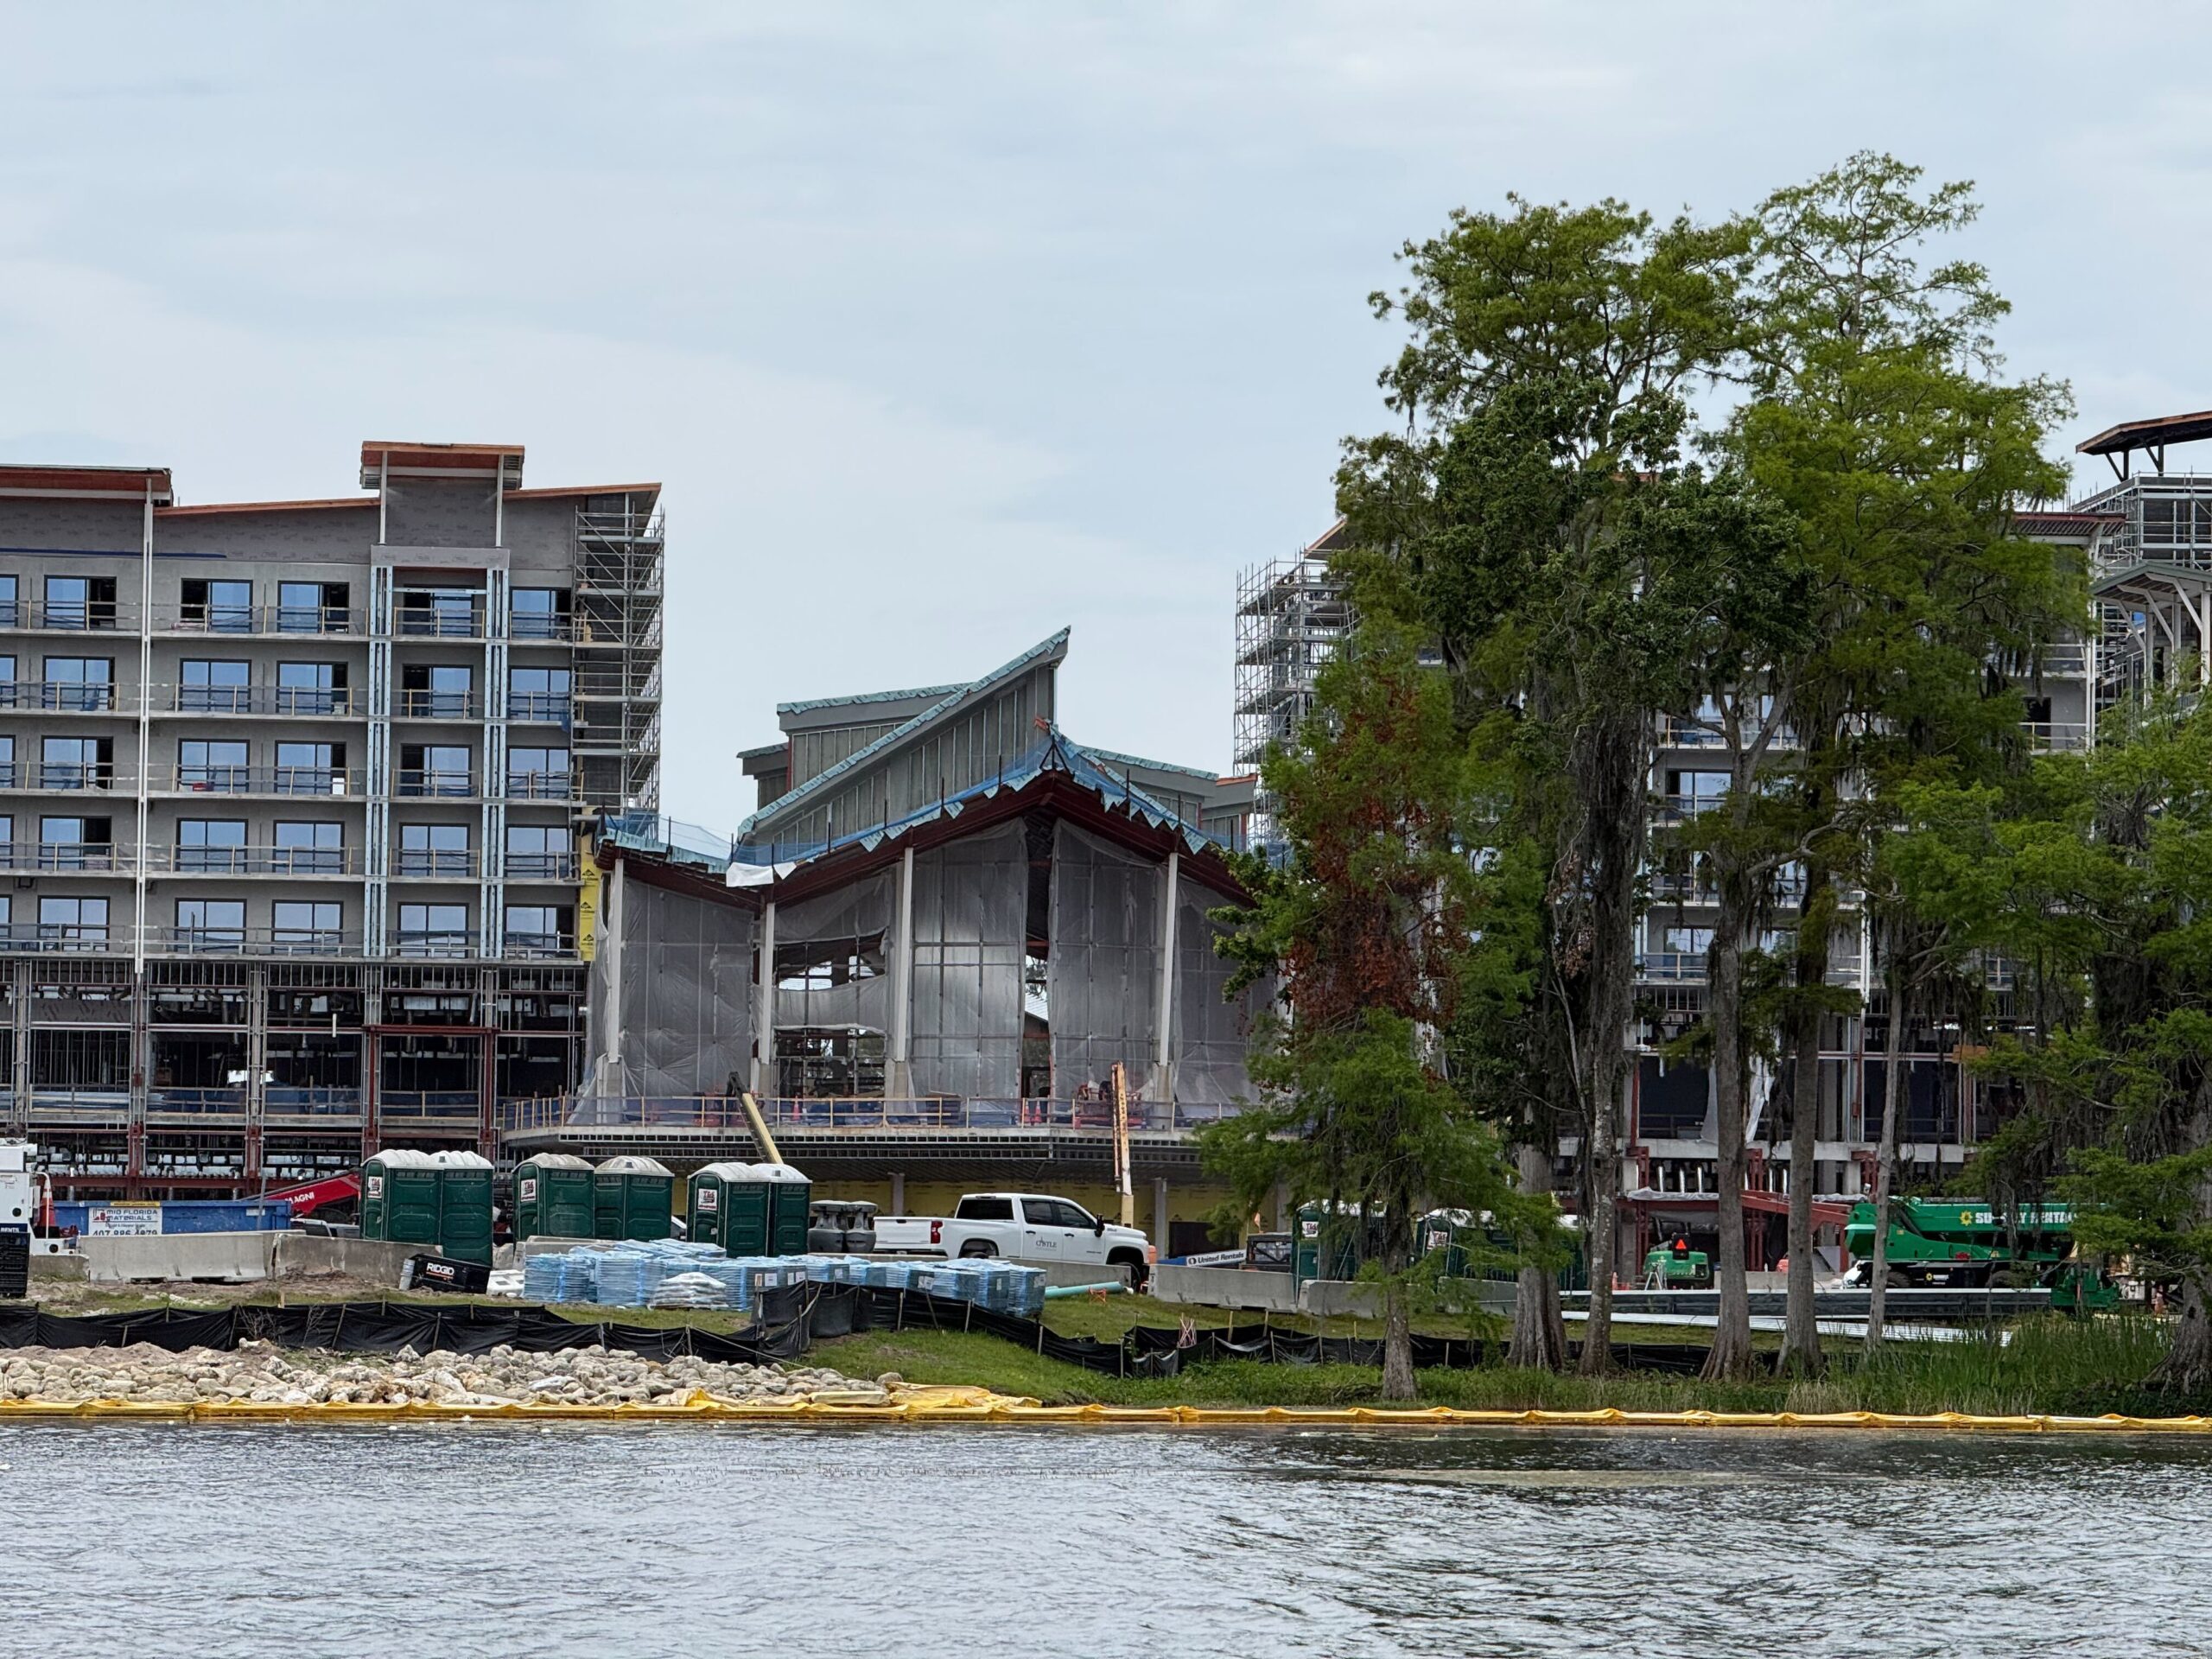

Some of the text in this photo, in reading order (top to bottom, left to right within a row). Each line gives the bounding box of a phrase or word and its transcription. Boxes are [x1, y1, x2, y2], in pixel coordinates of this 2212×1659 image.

[1198, 1251, 1244, 1264] United Rentals
[426, 1262, 454, 1275] RIDGID
